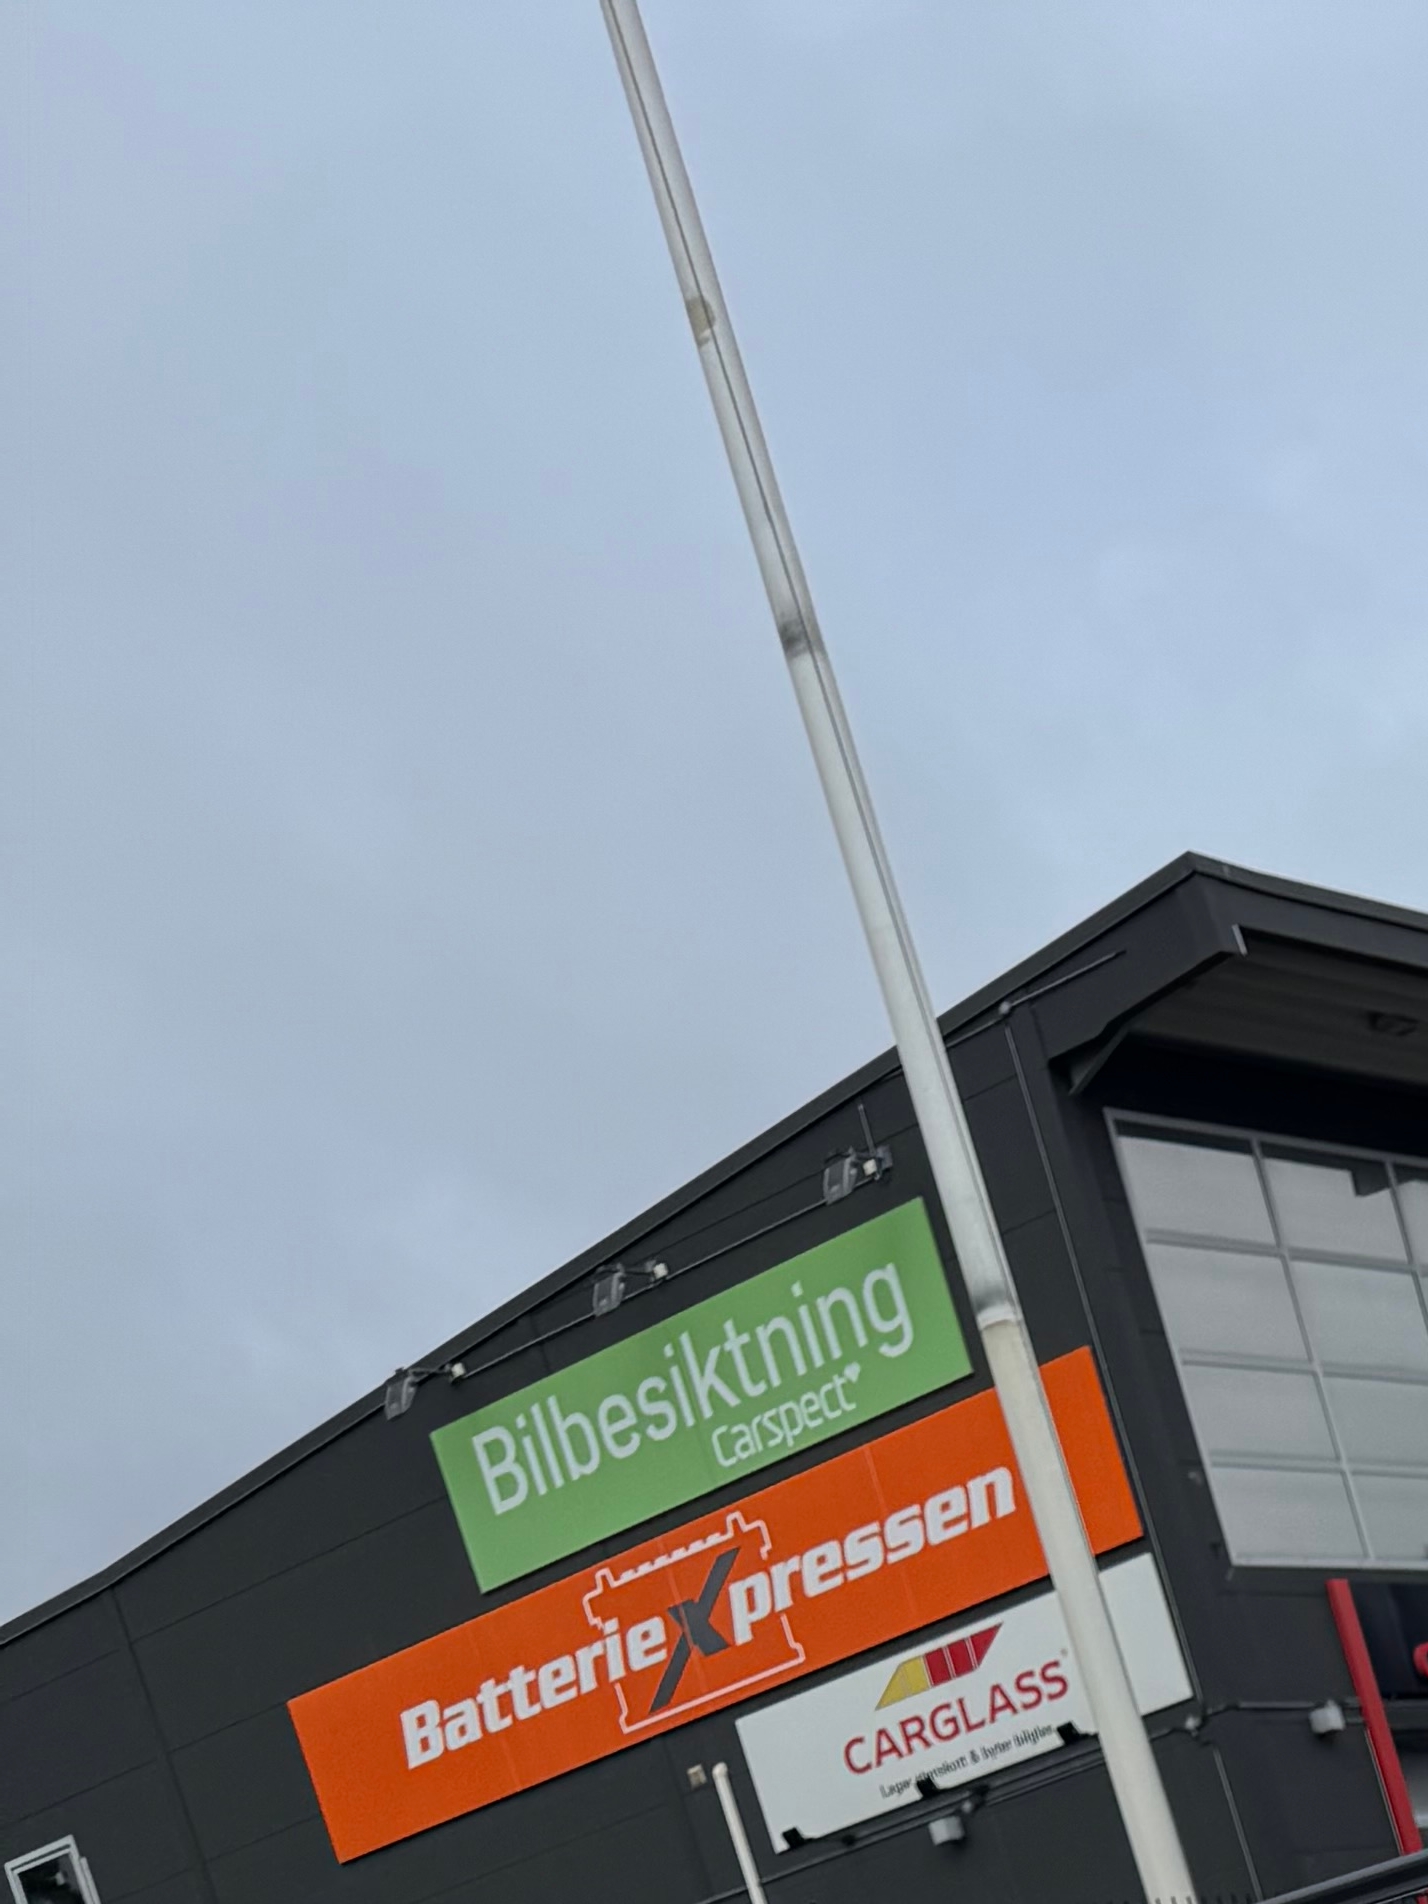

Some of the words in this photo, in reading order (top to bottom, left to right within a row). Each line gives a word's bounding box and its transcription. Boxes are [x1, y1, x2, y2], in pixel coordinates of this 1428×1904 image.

[472, 1262, 915, 1517] Bilbesiktning
[712, 1380, 857, 1469] Carspect
[401, 1464, 1017, 1771] BatterieXpressen
[843, 1660, 1069, 1775] CARGLASS
